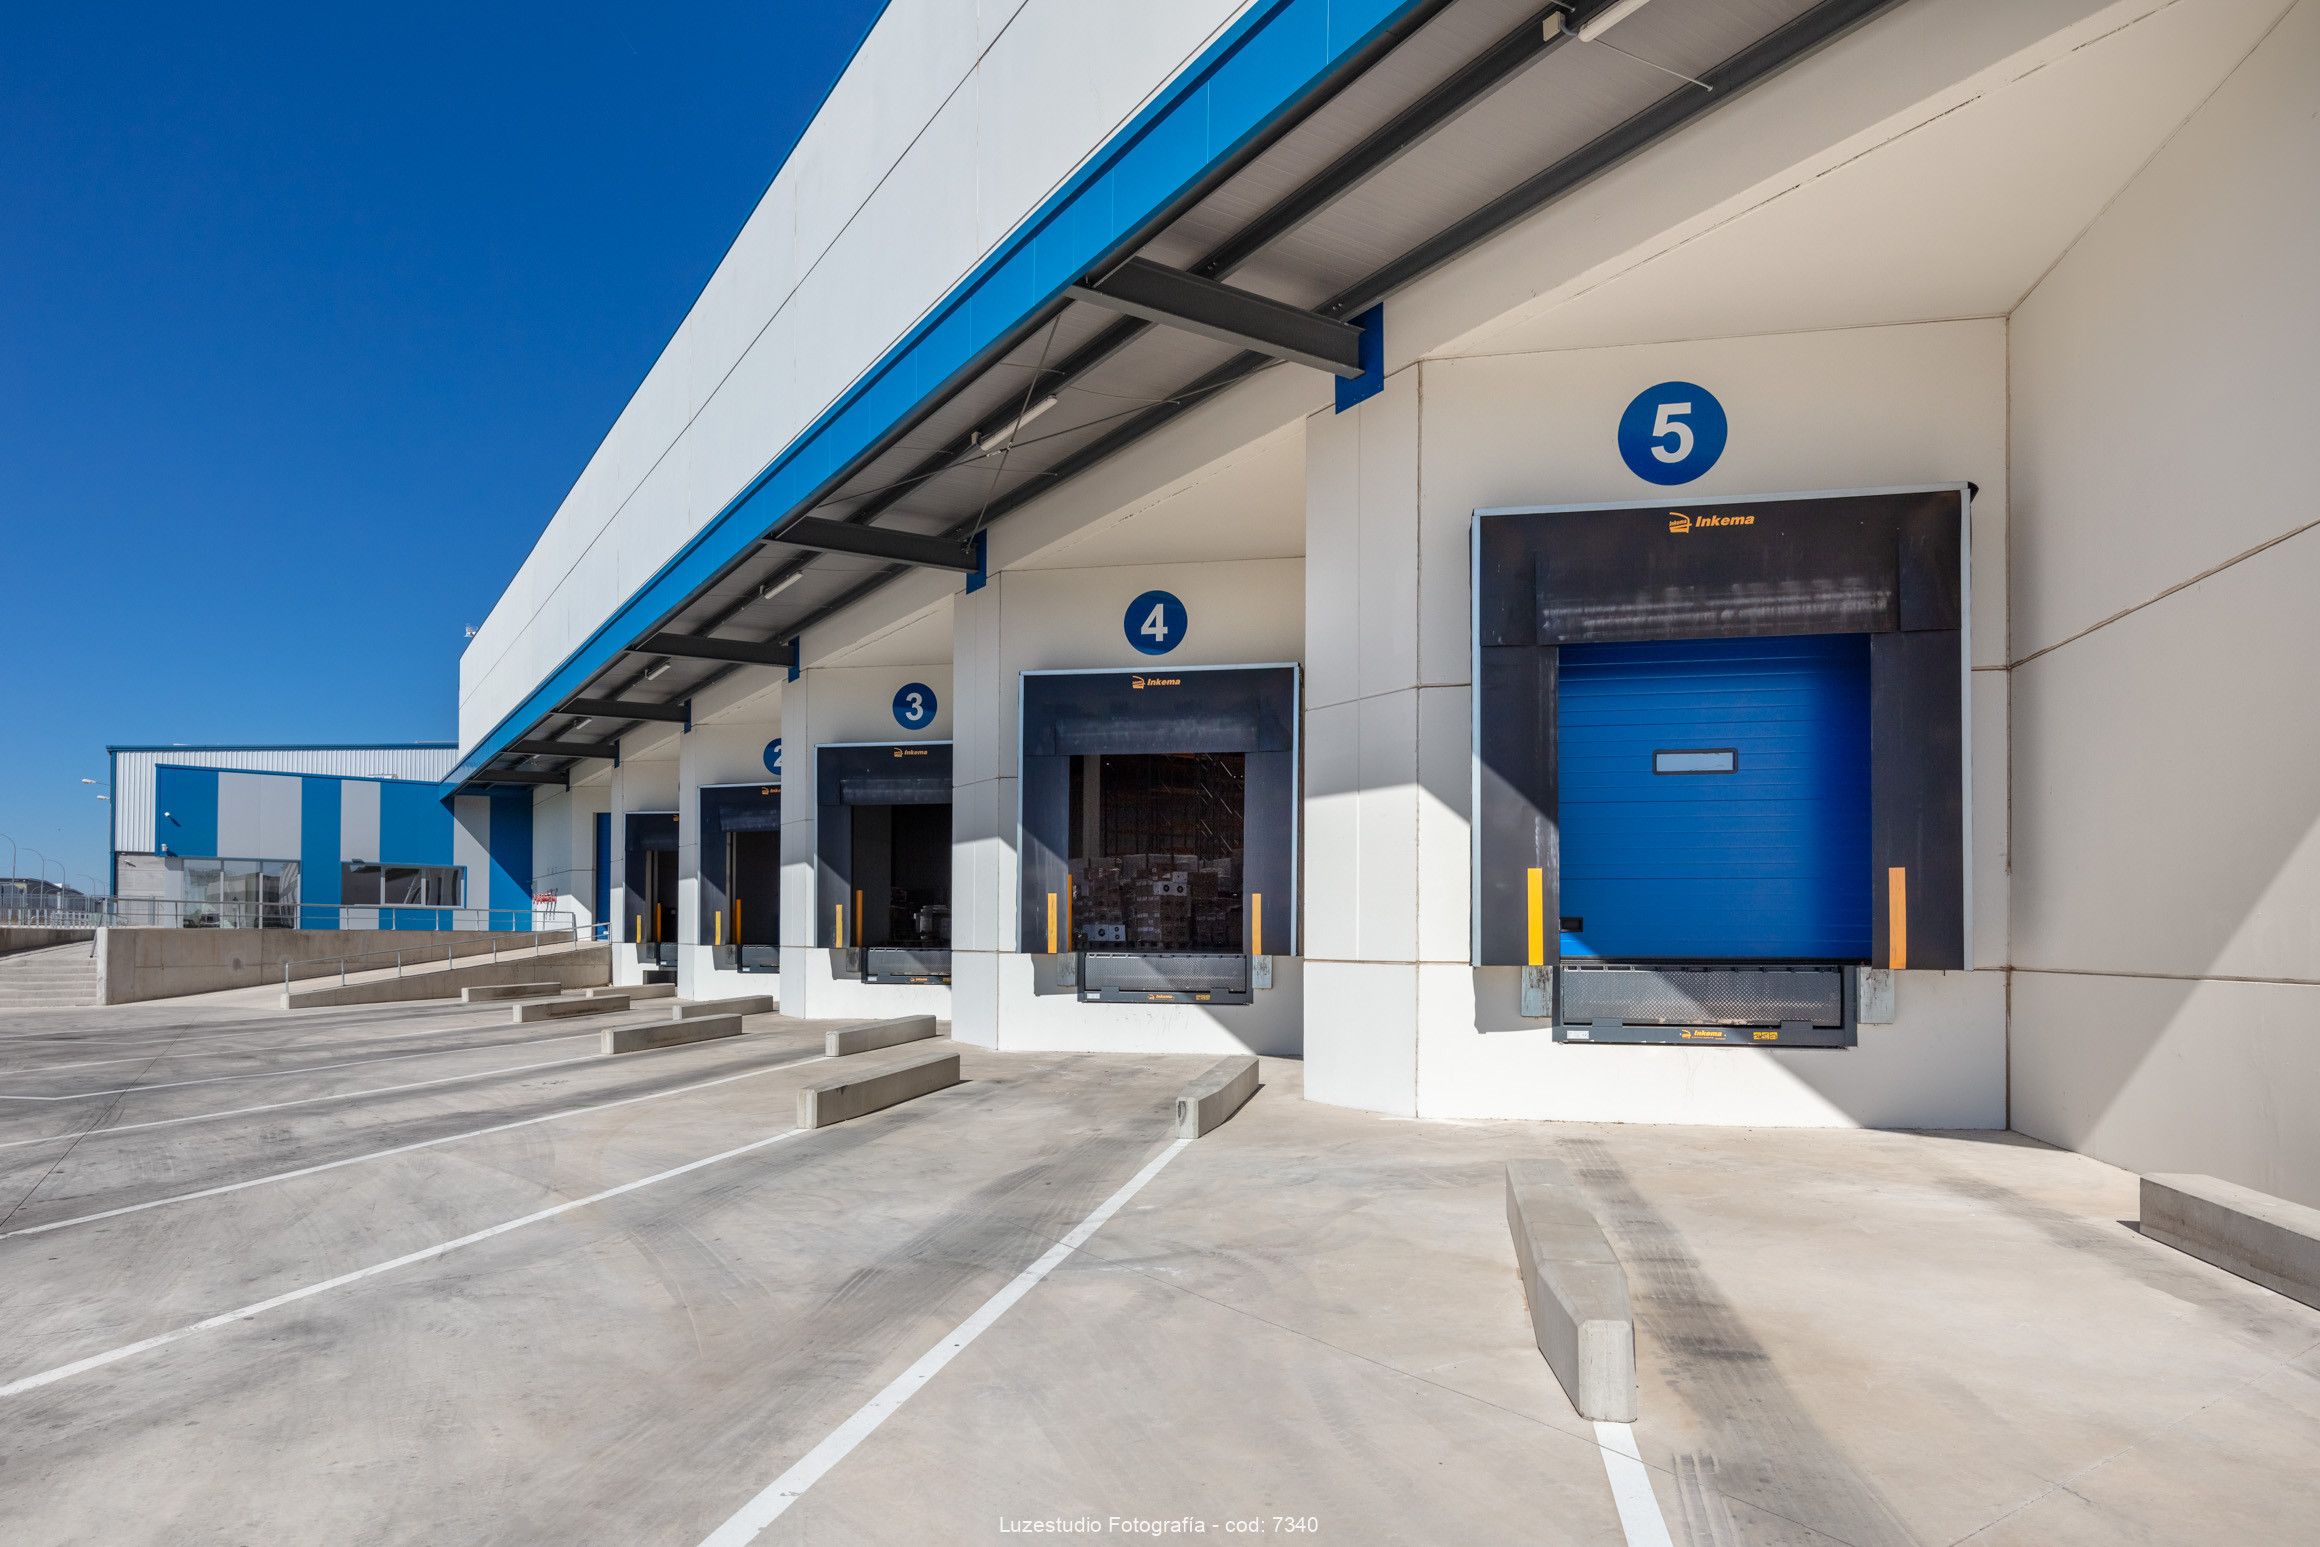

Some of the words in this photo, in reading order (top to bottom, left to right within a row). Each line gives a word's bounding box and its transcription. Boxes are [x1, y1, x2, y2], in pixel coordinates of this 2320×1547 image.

[1651, 402, 1694, 463] 5
[1695, 515, 1755, 527] Inkema
[1141, 603, 1168, 642] 4
[1147, 678, 1181, 686] Inkema
[905, 692, 924, 721] 3
